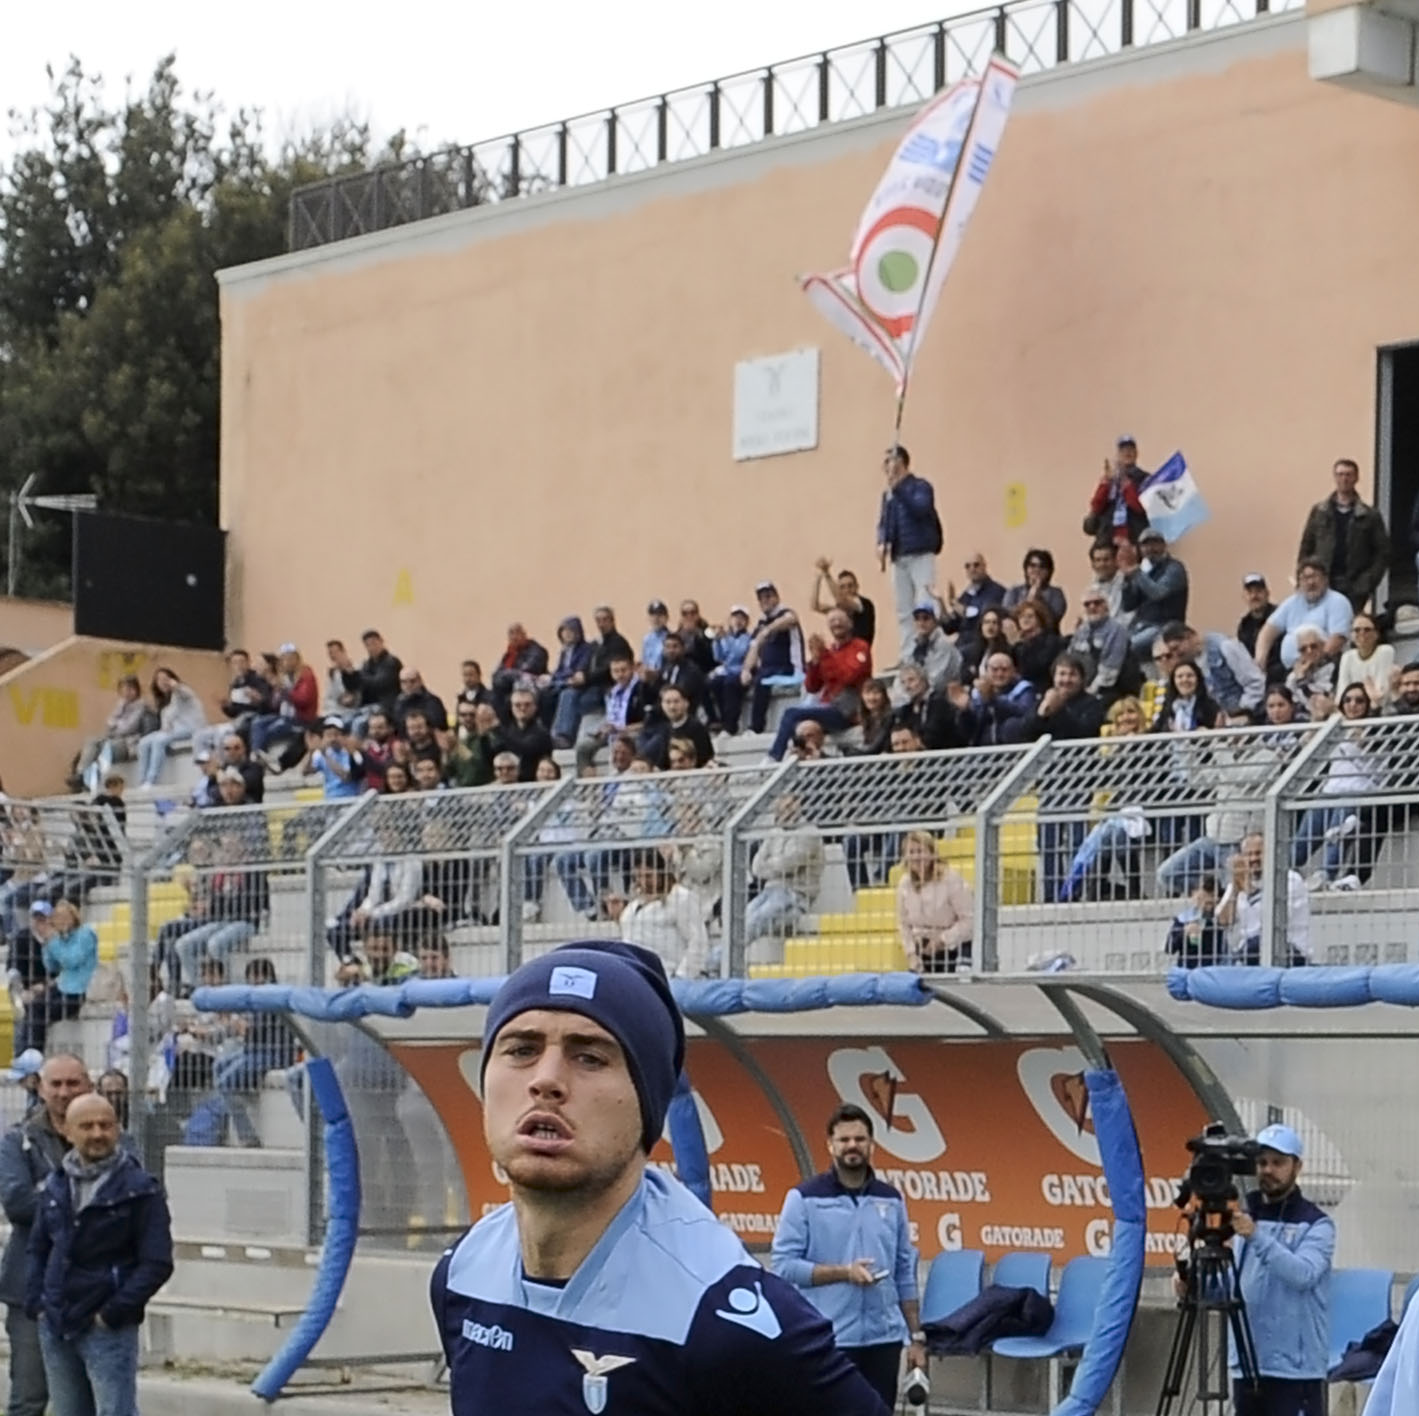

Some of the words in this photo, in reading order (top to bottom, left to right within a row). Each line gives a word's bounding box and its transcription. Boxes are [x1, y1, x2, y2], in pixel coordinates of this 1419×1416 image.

[937, 1212, 963, 1251] G
[980, 1225, 1065, 1248] GATORADE
[1085, 1218, 1111, 1258] G
[462, 1318, 513, 1352] macron
